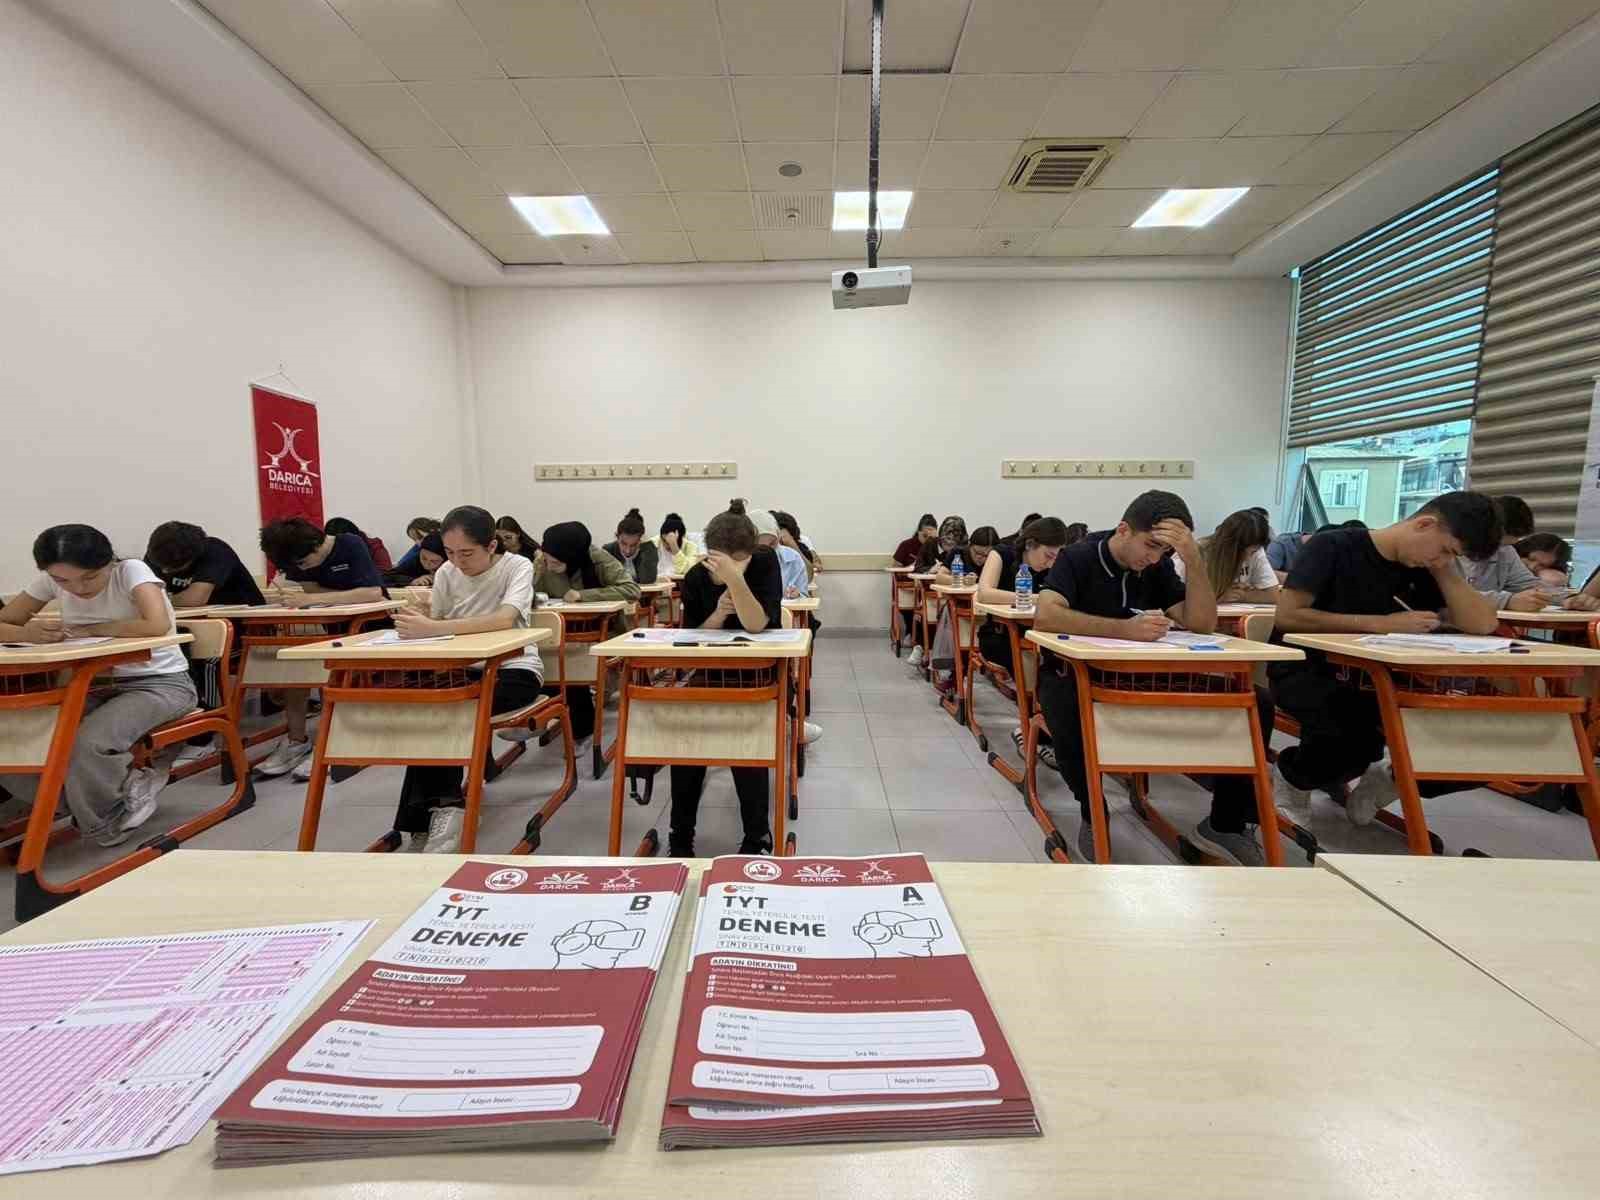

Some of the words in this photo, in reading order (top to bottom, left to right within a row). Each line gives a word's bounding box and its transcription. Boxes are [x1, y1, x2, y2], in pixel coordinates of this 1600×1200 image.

[268, 469, 312, 487] DARICA
[903, 886, 923, 902] A
[629, 895, 652, 911] B
[723, 896, 768, 909] TYT
[438, 904, 489, 921] TYT
[719, 918, 826, 937] DENEME
[411, 928, 529, 947] DENEME
[713, 958, 745, 966] ADAYIN
[376, 970, 410, 979] ADAYIN
